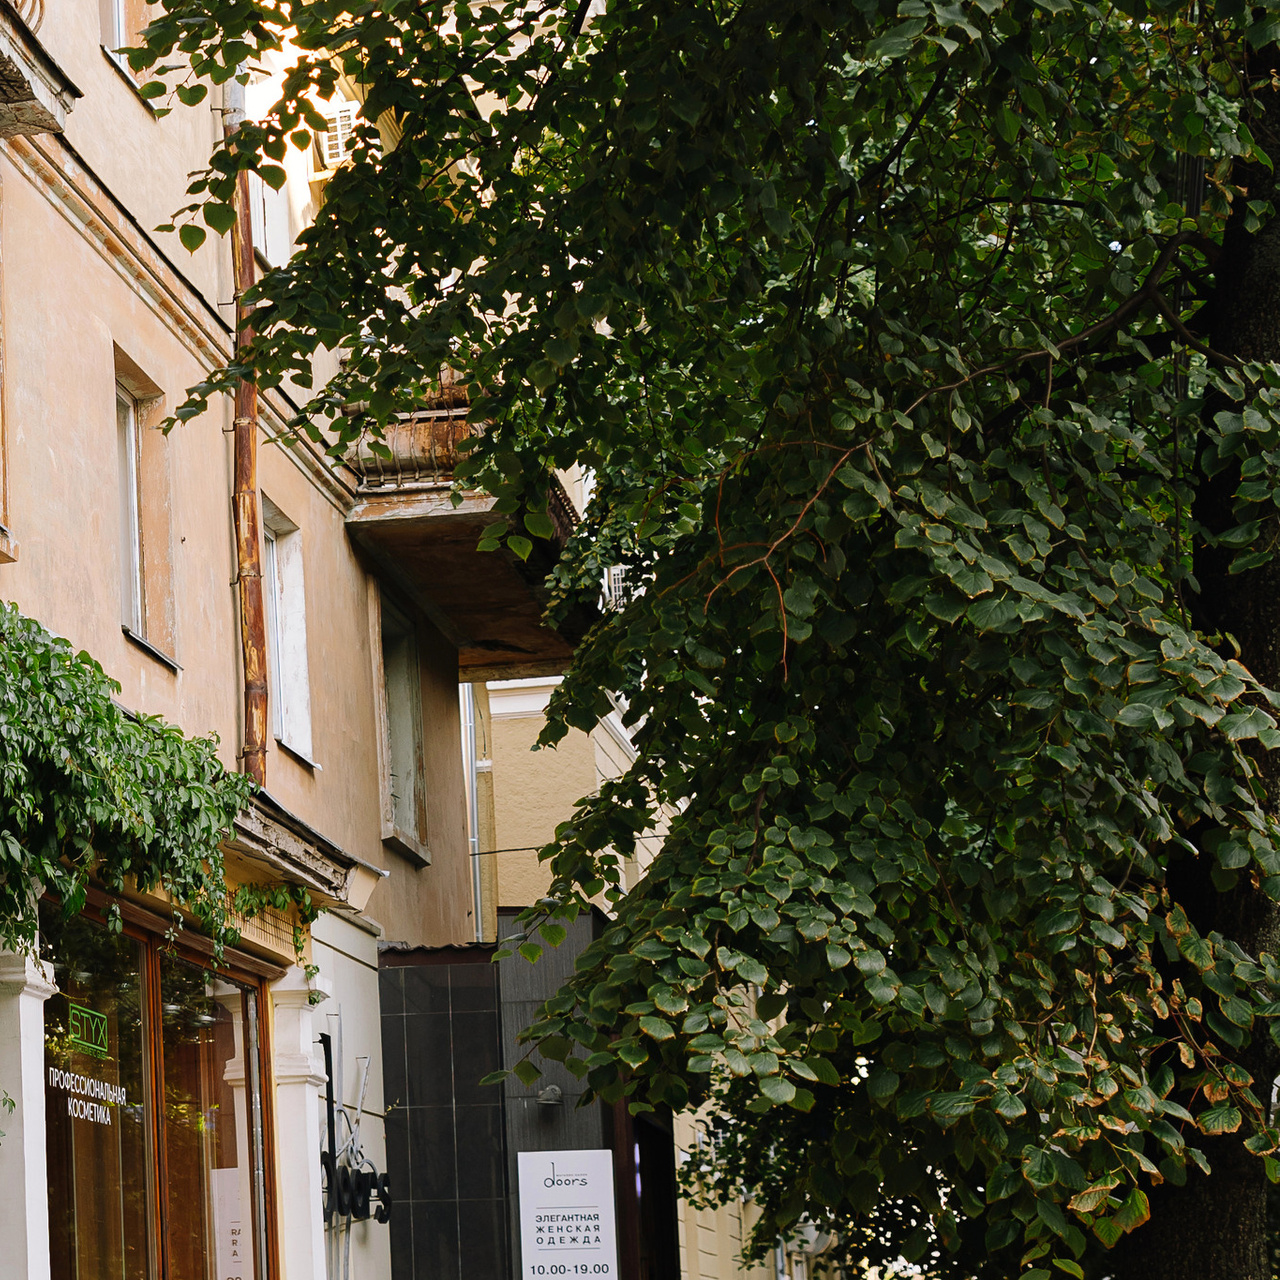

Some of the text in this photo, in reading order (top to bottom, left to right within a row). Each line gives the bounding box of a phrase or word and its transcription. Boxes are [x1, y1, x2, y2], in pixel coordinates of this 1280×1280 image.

[71, 1009, 108, 1048] STYX
[49, 1066, 127, 1106] ПРОФЕССИОНАЛЬНАЯ
[67, 1097, 112, 1126] КОСМЕТИКА
[543, 1161, 588, 1188] doors
[535, 1213, 600, 1223] ЭЛЕГАНТНАЯ
[535, 1224, 601, 1234] ЖЕНСКАЯ
[536, 1235, 601, 1246] ОДЕЖДА
[530, 1263, 610, 1275] 10.00-19.00
